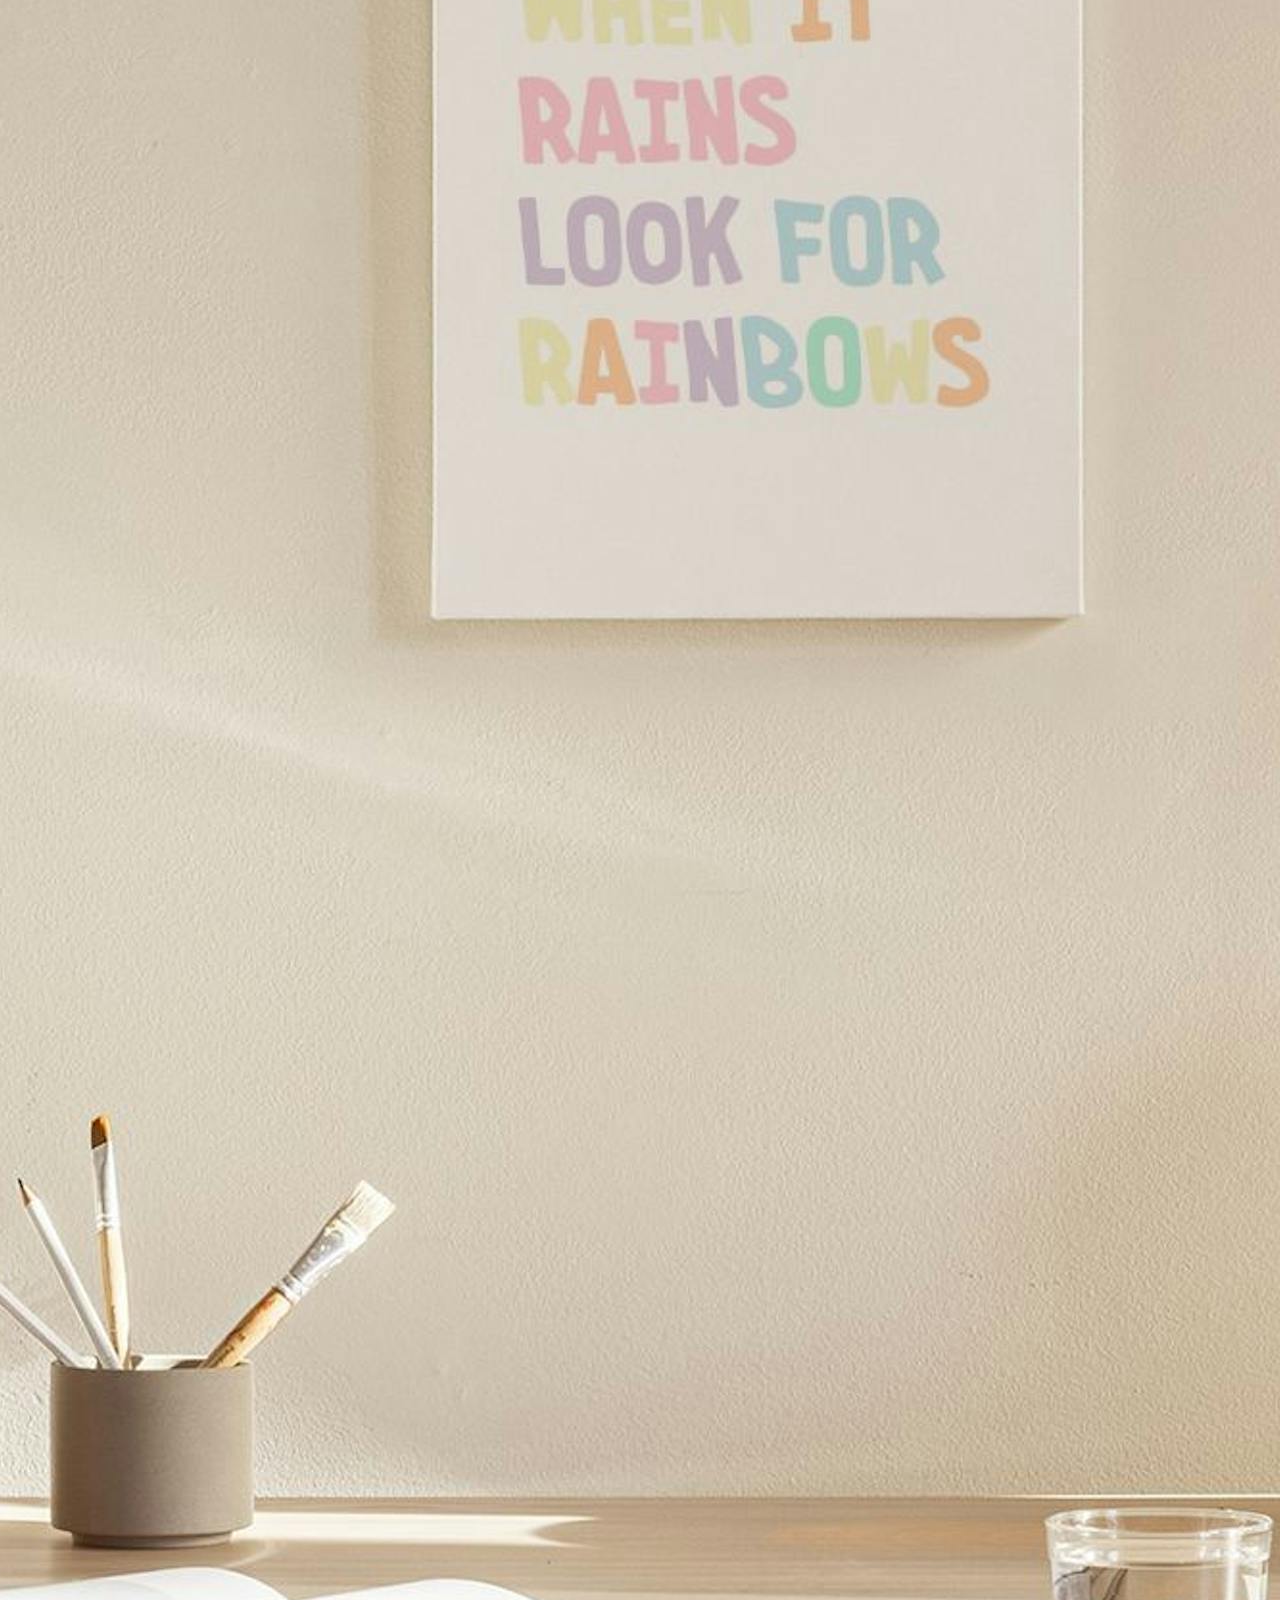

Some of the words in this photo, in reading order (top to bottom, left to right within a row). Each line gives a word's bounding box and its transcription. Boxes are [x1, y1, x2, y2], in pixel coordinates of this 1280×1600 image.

[518, 75, 798, 167] RAINS
[518, 195, 743, 288] LOOK
[774, 195, 946, 288] FOR
[518, 315, 991, 410] RAINBOWS
